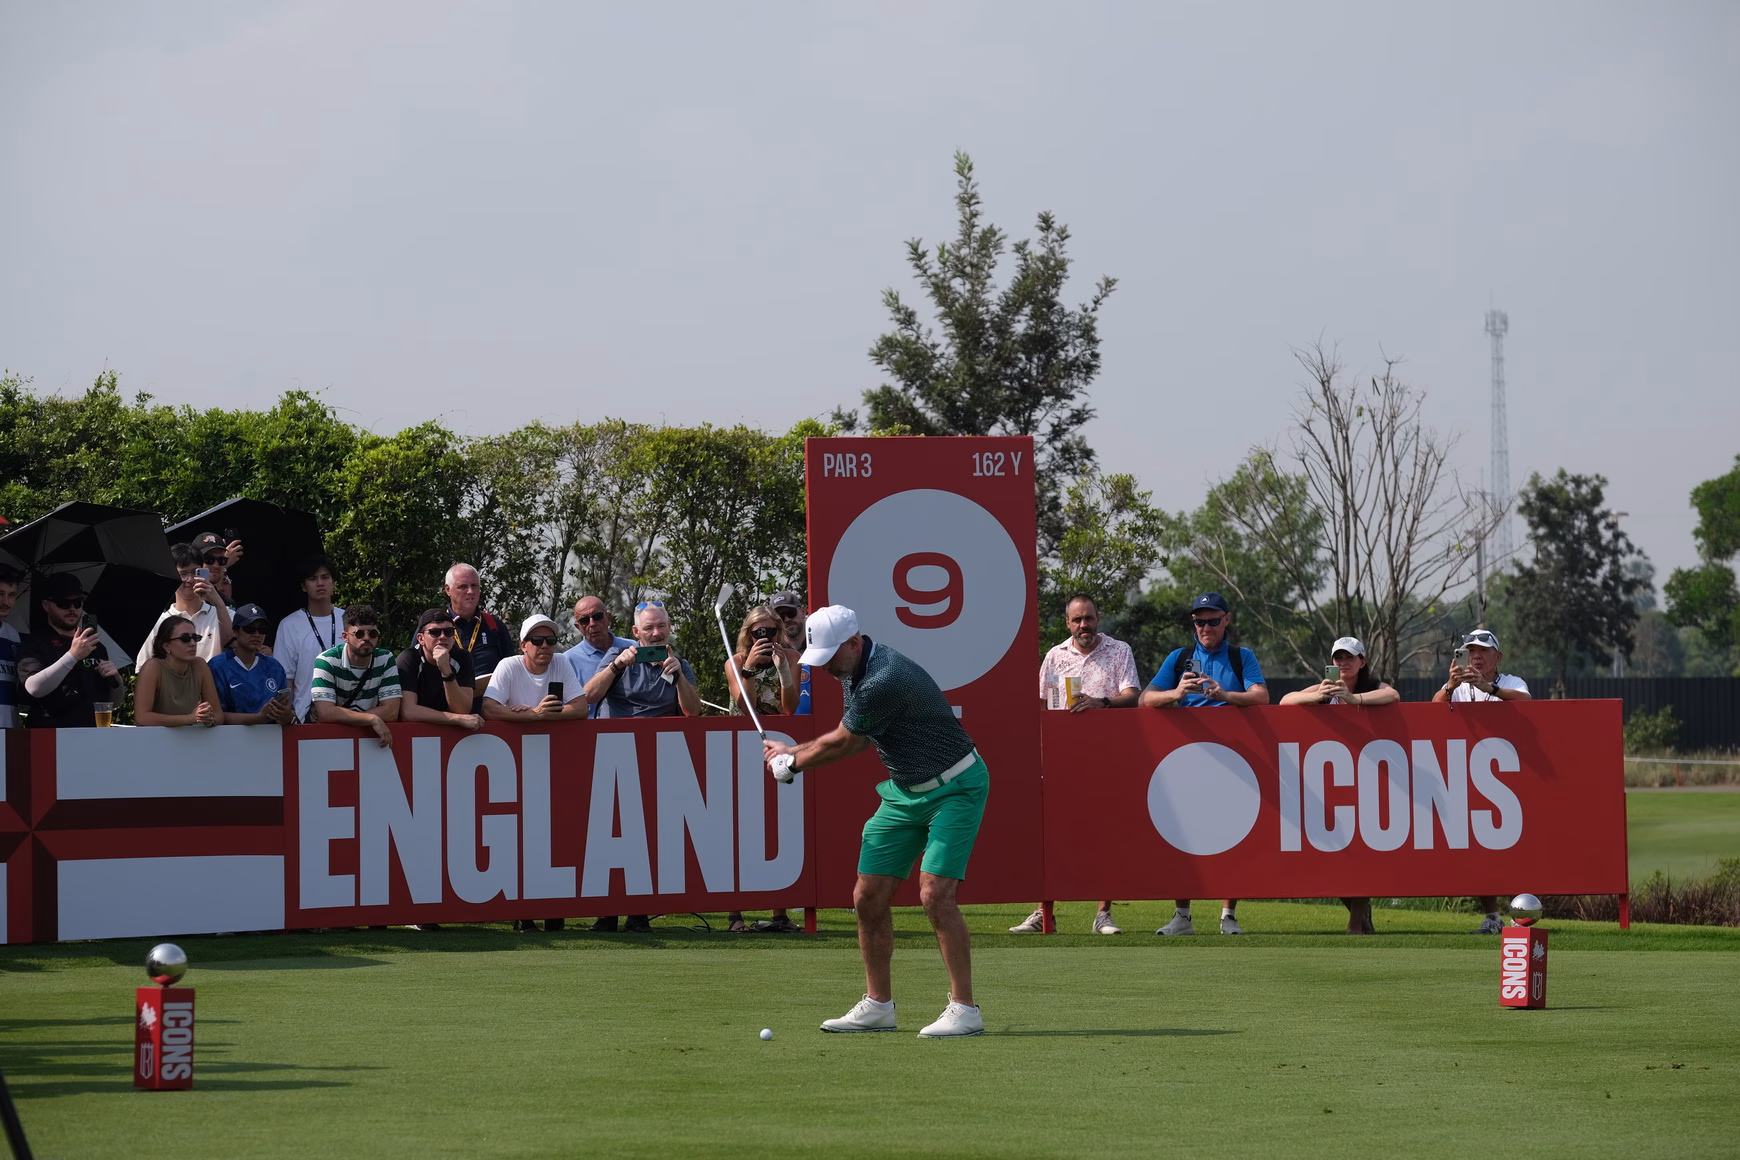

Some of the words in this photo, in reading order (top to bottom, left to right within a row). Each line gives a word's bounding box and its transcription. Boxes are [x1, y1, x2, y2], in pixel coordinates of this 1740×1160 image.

[823, 453, 857, 478] PAR
[860, 453, 872, 478] 3
[972, 452, 1006, 477] 162
[1010, 452, 1022, 476] Y
[892, 551, 964, 629] 9
[298, 730, 805, 910] ENGLAND
[1278, 737, 1523, 852] ICONS
[1501, 937, 1528, 999] ICONS
[161, 1002, 193, 1081] ICONS
